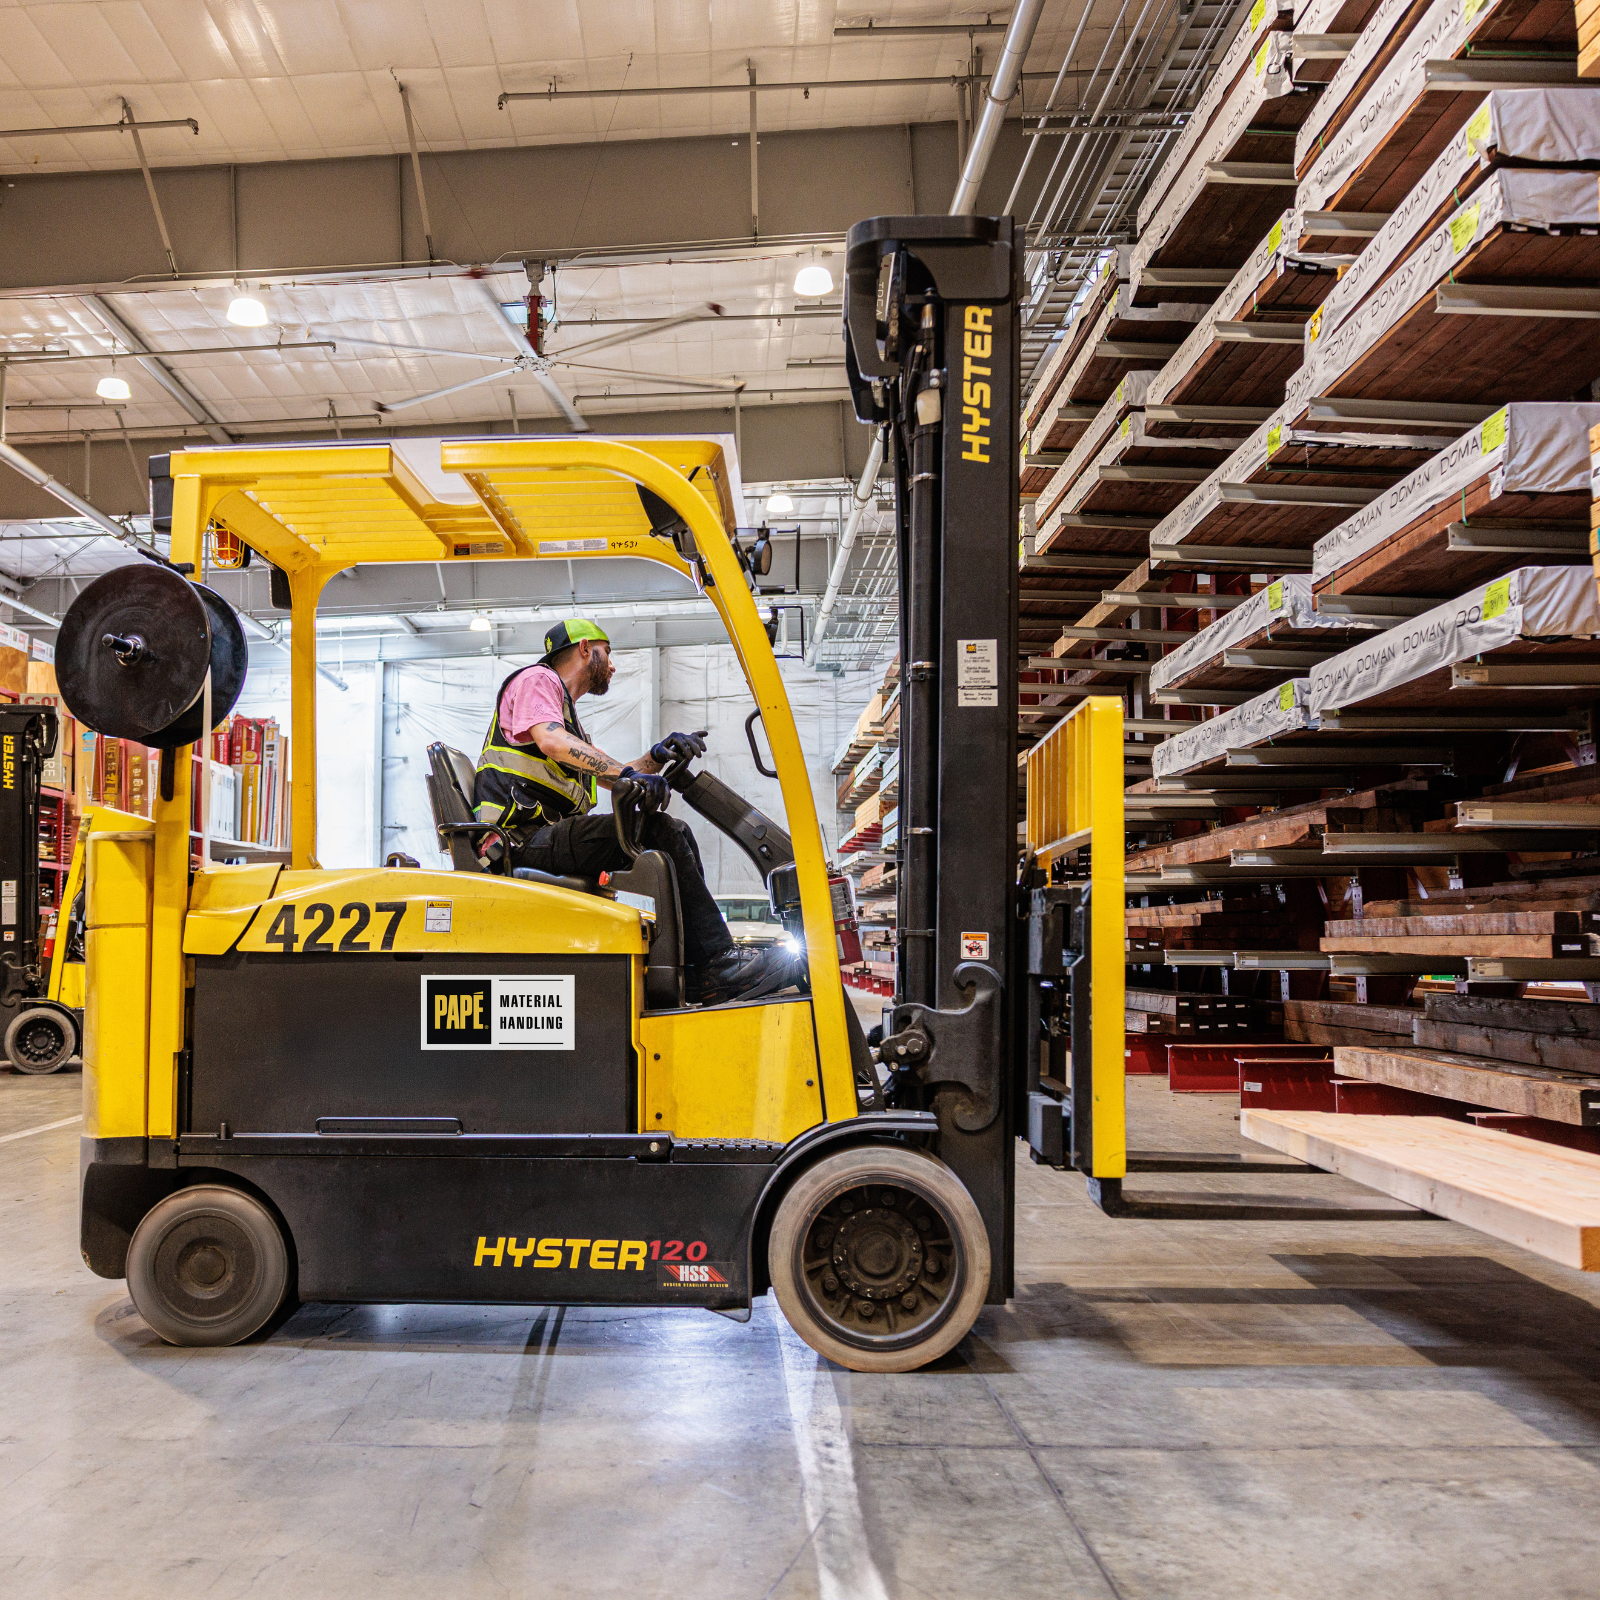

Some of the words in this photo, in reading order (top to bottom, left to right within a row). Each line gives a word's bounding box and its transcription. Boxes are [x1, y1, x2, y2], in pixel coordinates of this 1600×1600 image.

[1360, 69, 1405, 134] DOMAN
[1410, 1, 1461, 72] DOMAN
[1342, 238, 1382, 295] DOMAN
[1388, 177, 1431, 241] DOMAN
[1371, 261, 1418, 318] DOMAN
[961, 304, 993, 464] HYSTER
[1347, 500, 1385, 540] DOMAN
[1390, 464, 1433, 510] DOMAN
[1440, 431, 1483, 476] DOMA
[1317, 662, 1350, 693] DOMAN
[1356, 642, 1397, 675] DOMAN
[1403, 615, 1449, 654] DOMAN
[3, 734, 15, 790] HYSTER
[265, 902, 408, 953] 4227
[434, 990, 484, 1030] PAPÉ
[499, 994, 563, 1008] MATERIAL
[499, 1016, 563, 1030] HANDLING
[473, 1236, 648, 1271] HYSTER
[650, 1240, 708, 1262] 120
[679, 1264, 710, 1282] HSS
